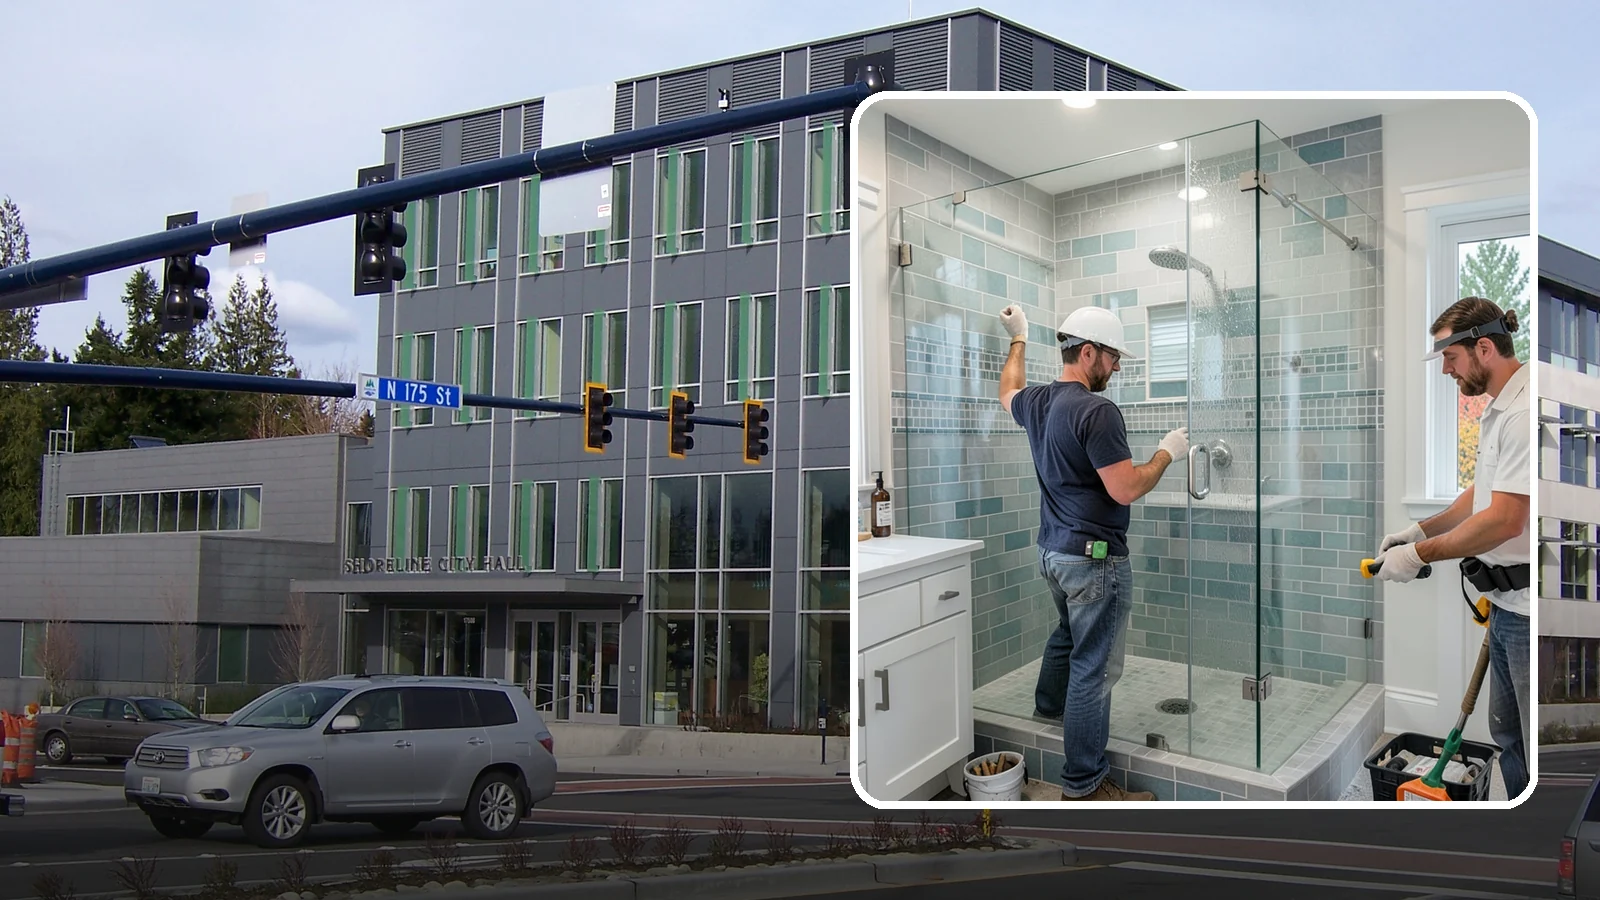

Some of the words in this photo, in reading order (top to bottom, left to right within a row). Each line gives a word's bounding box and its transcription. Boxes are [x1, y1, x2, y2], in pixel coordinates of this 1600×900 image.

[387, 380, 396, 400] N
[405, 383, 427, 403] 175
[436, 386, 452, 406] St
[344, 557, 432, 574] SHORELINE
[438, 556, 476, 573] CITY
[484, 555, 525, 572] HALL
